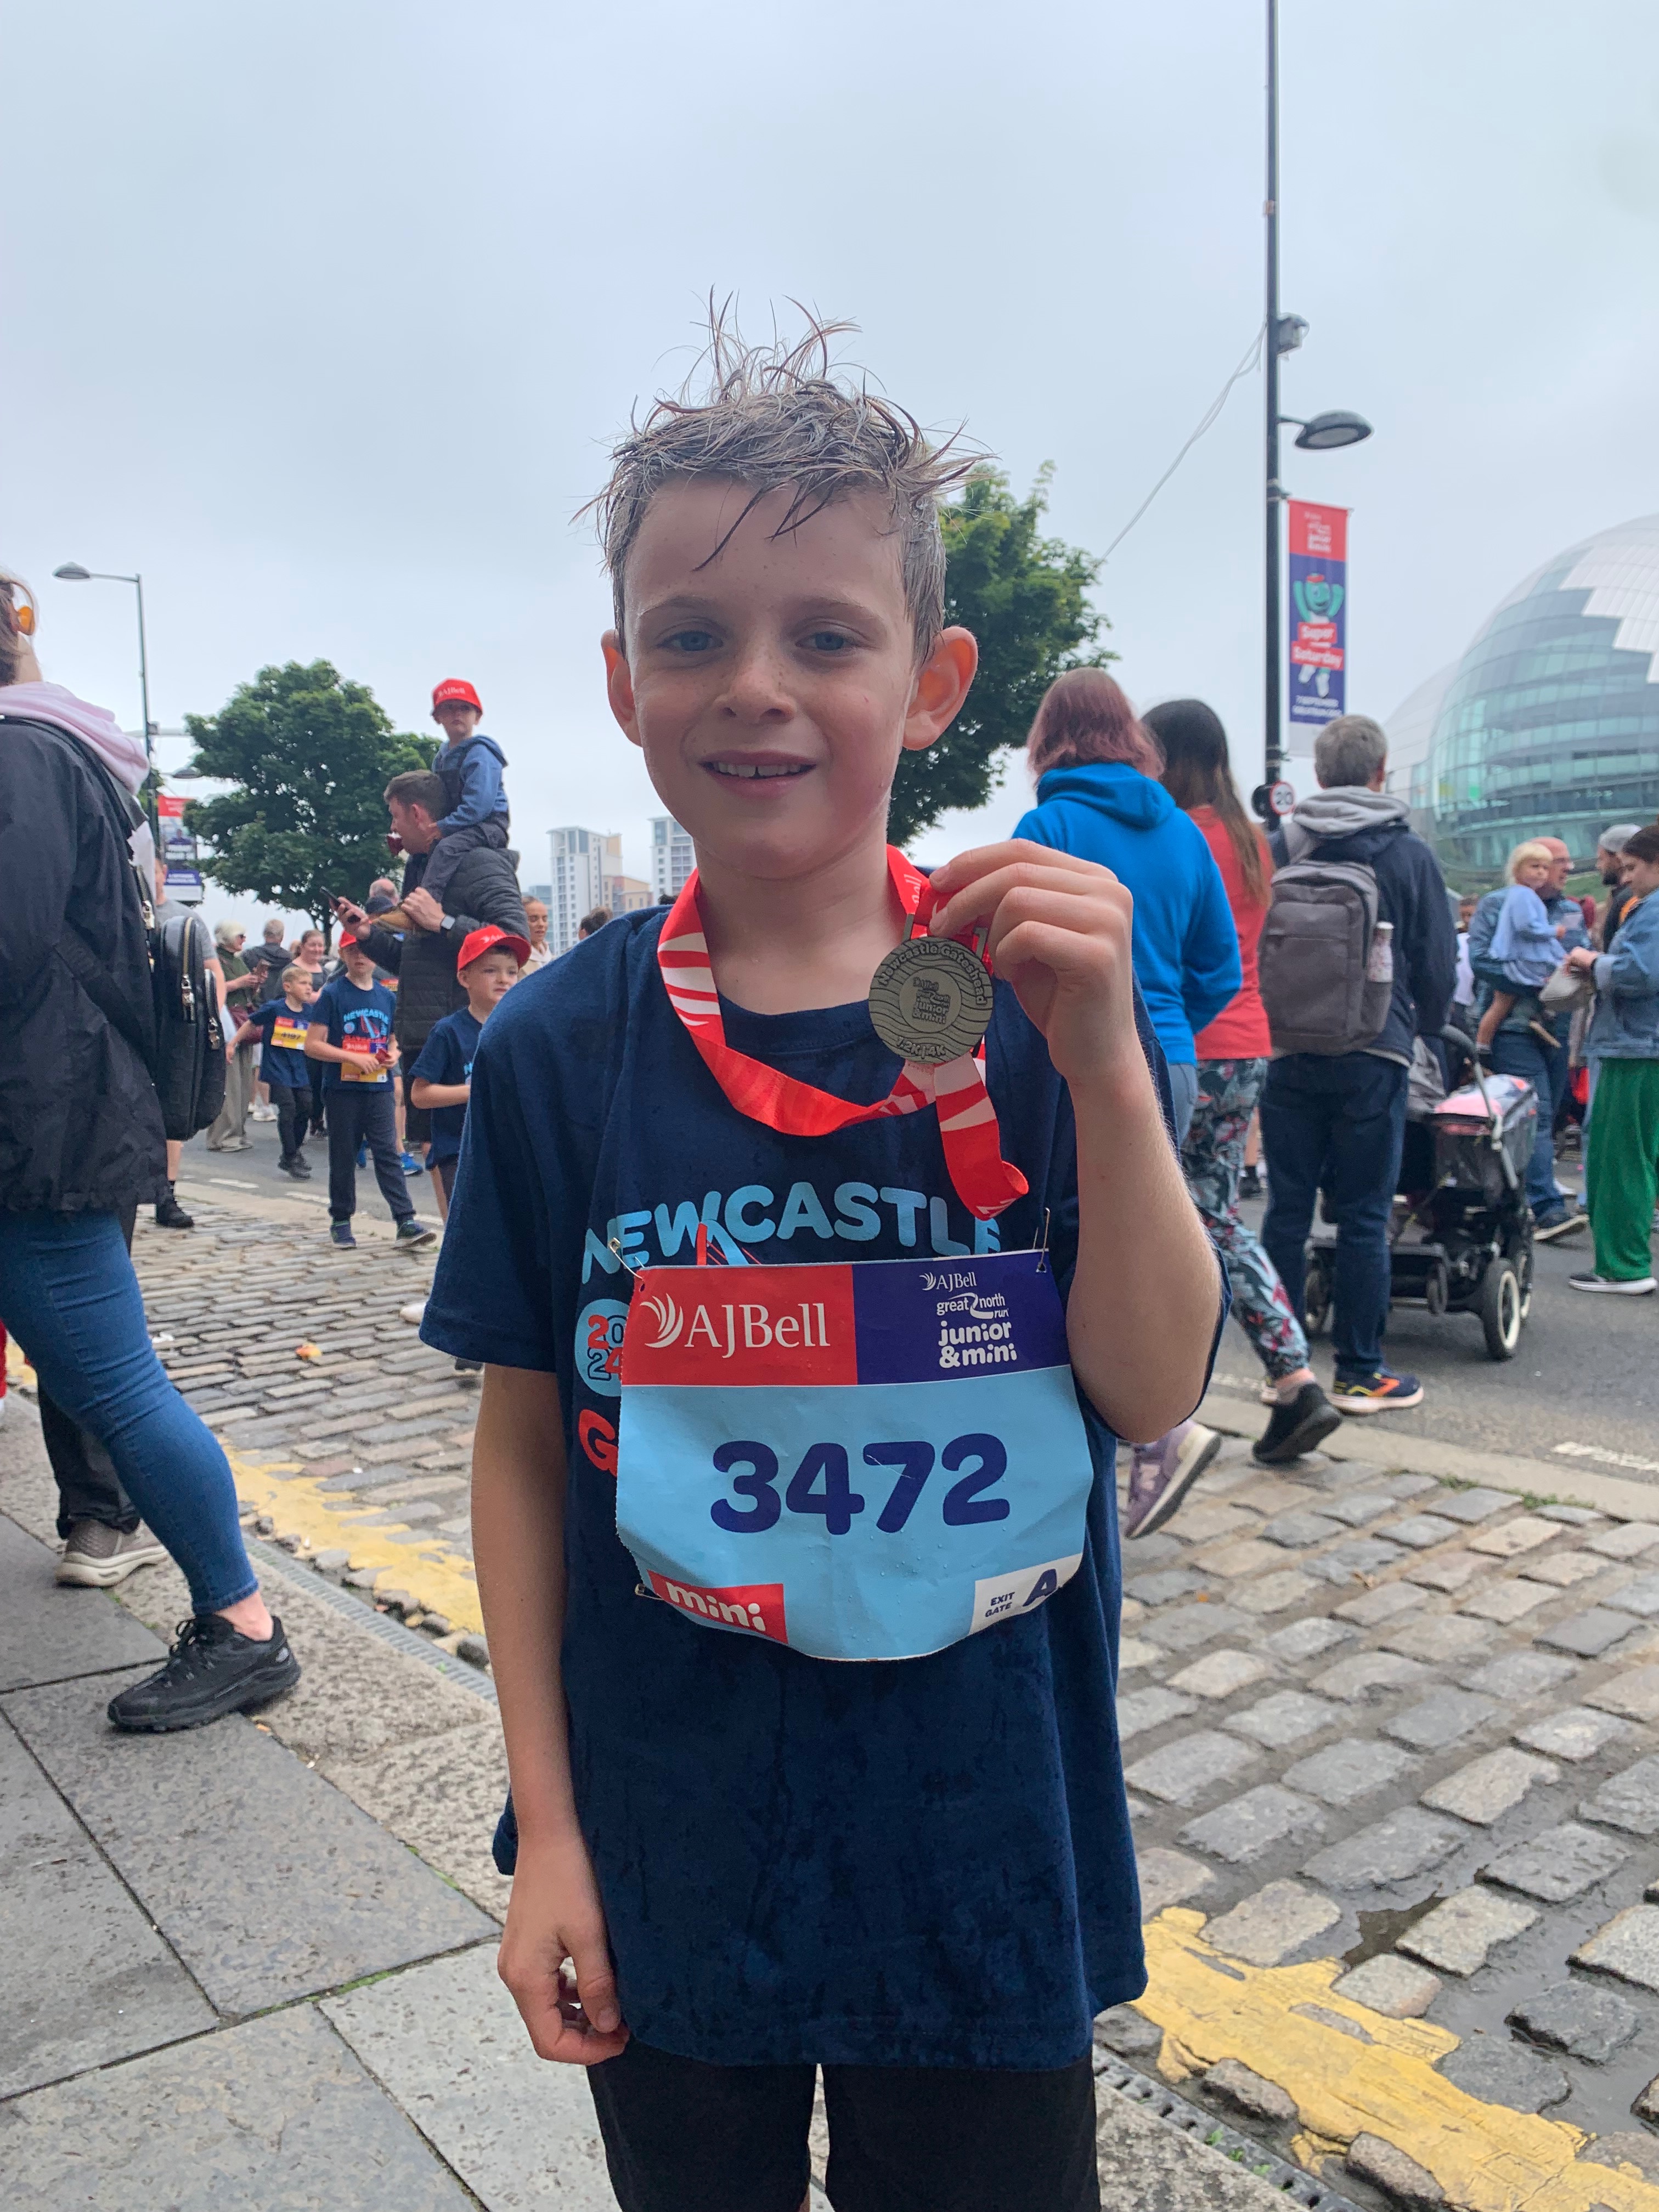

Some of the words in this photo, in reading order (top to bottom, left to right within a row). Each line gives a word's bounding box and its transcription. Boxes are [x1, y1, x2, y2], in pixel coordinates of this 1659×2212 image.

[1294, 646, 1344, 669] Saturday
[1276, 791, 1294, 805] 20
[878, 943, 938, 986] Newcastle
[940, 944, 987, 1005] Gateshead
[936, 1297, 969, 1316] great
[979, 1293, 1006, 1308] north
[994, 1310, 1009, 1318] run
[938, 1320, 1012, 1346] junior
[939, 1343, 1017, 1368] &mini
[710, 1433, 1011, 1534] 3472
[990, 1592, 1015, 1606] EXIT
[1022, 1568, 1058, 1607] A
[665, 1578, 766, 1632] mini
[985, 1602, 1012, 1617] GATE
